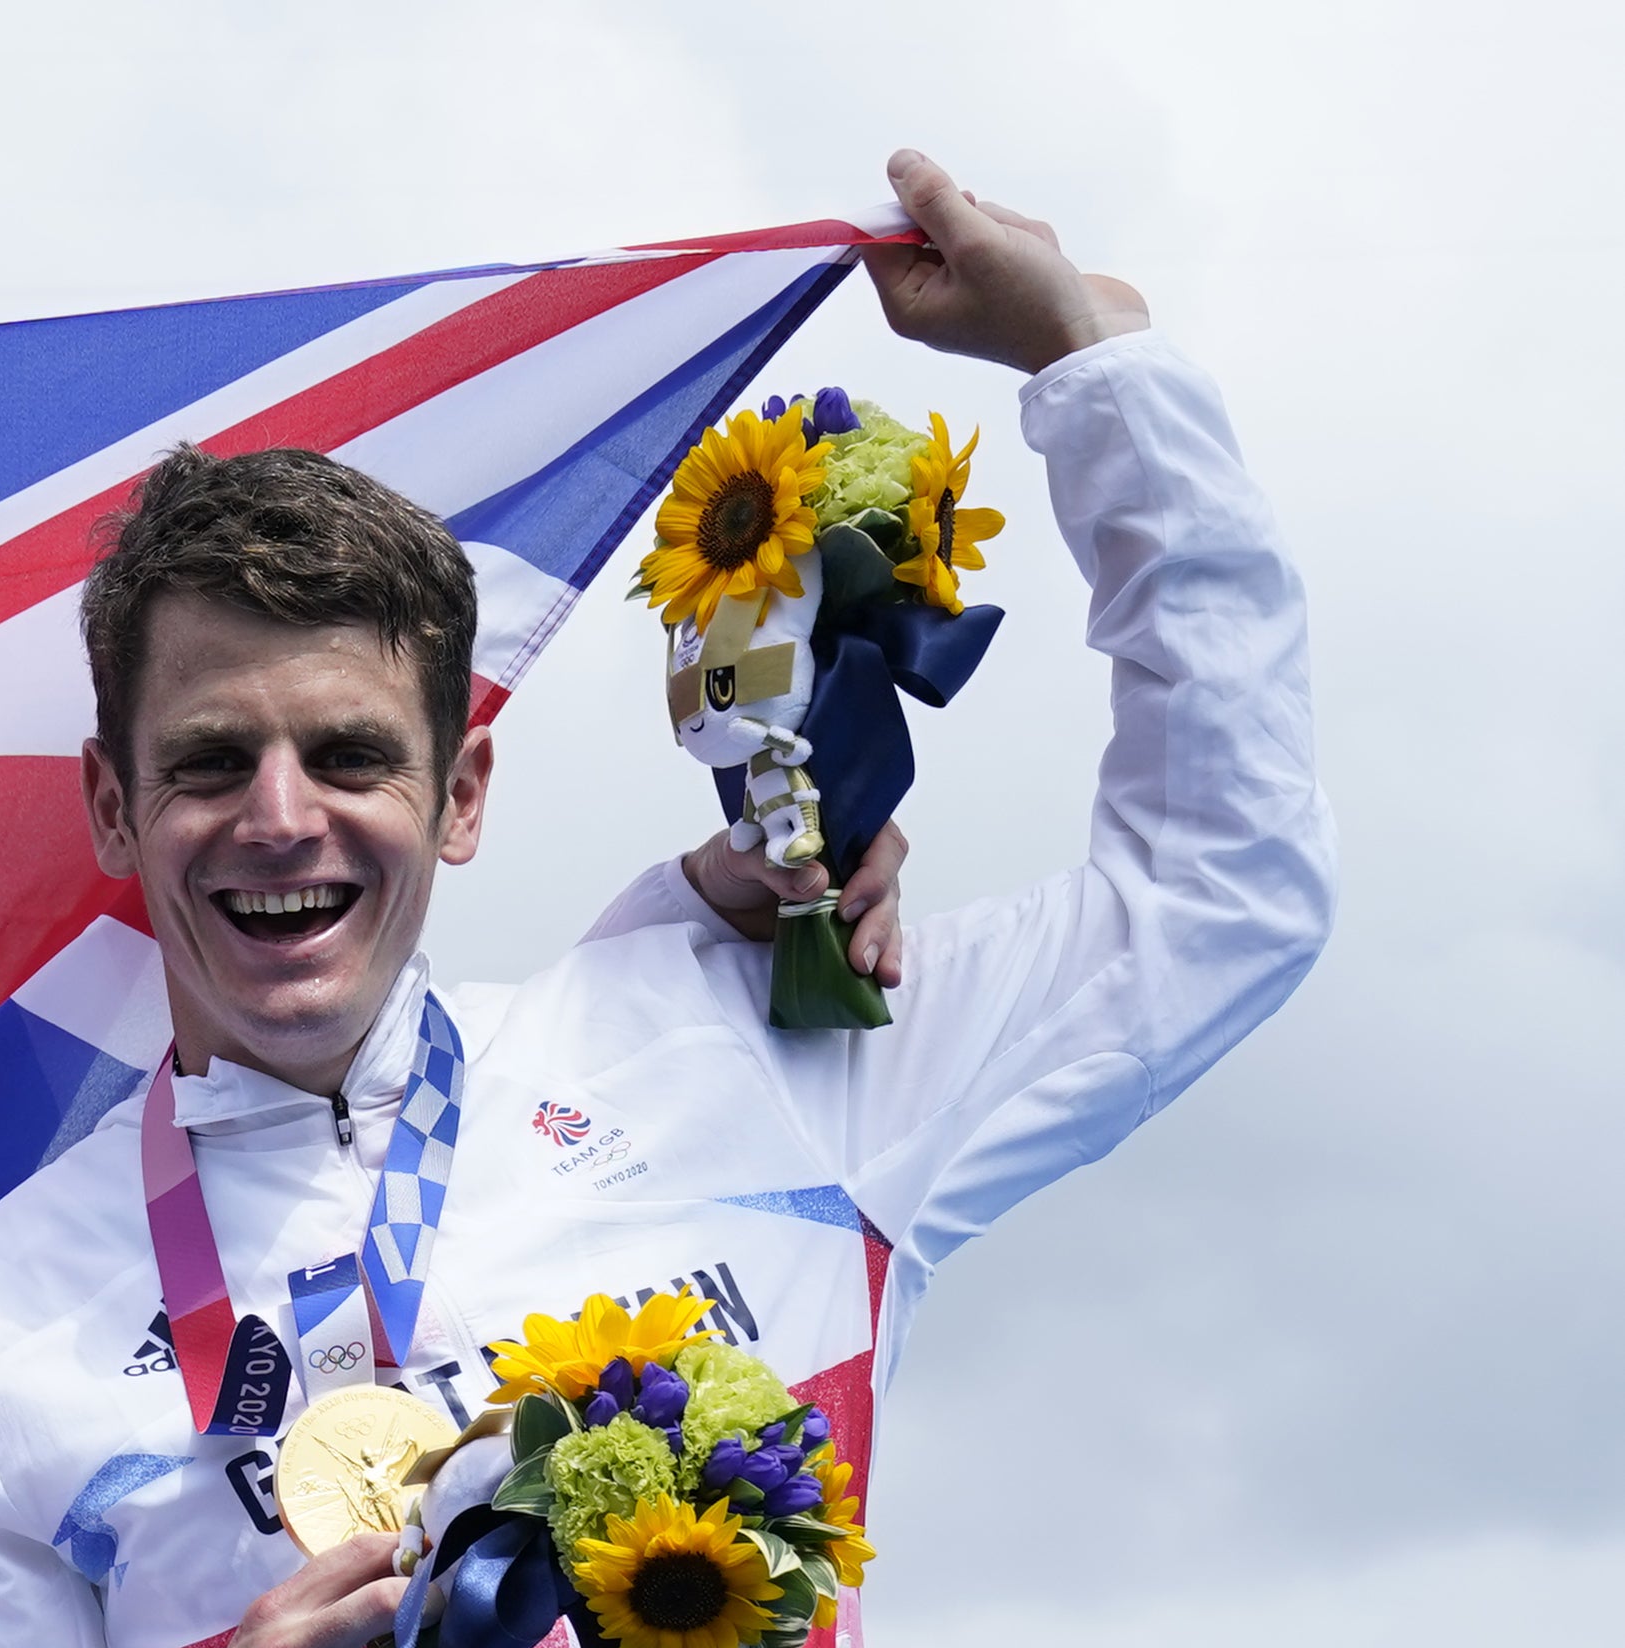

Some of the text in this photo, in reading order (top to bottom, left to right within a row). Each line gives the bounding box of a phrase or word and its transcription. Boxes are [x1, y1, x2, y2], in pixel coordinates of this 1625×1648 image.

[551, 1128, 624, 1176] TEAM GB
[592, 1161, 648, 1191] TOKYO 2020
[229, 1317, 279, 1435] KYO 2020
